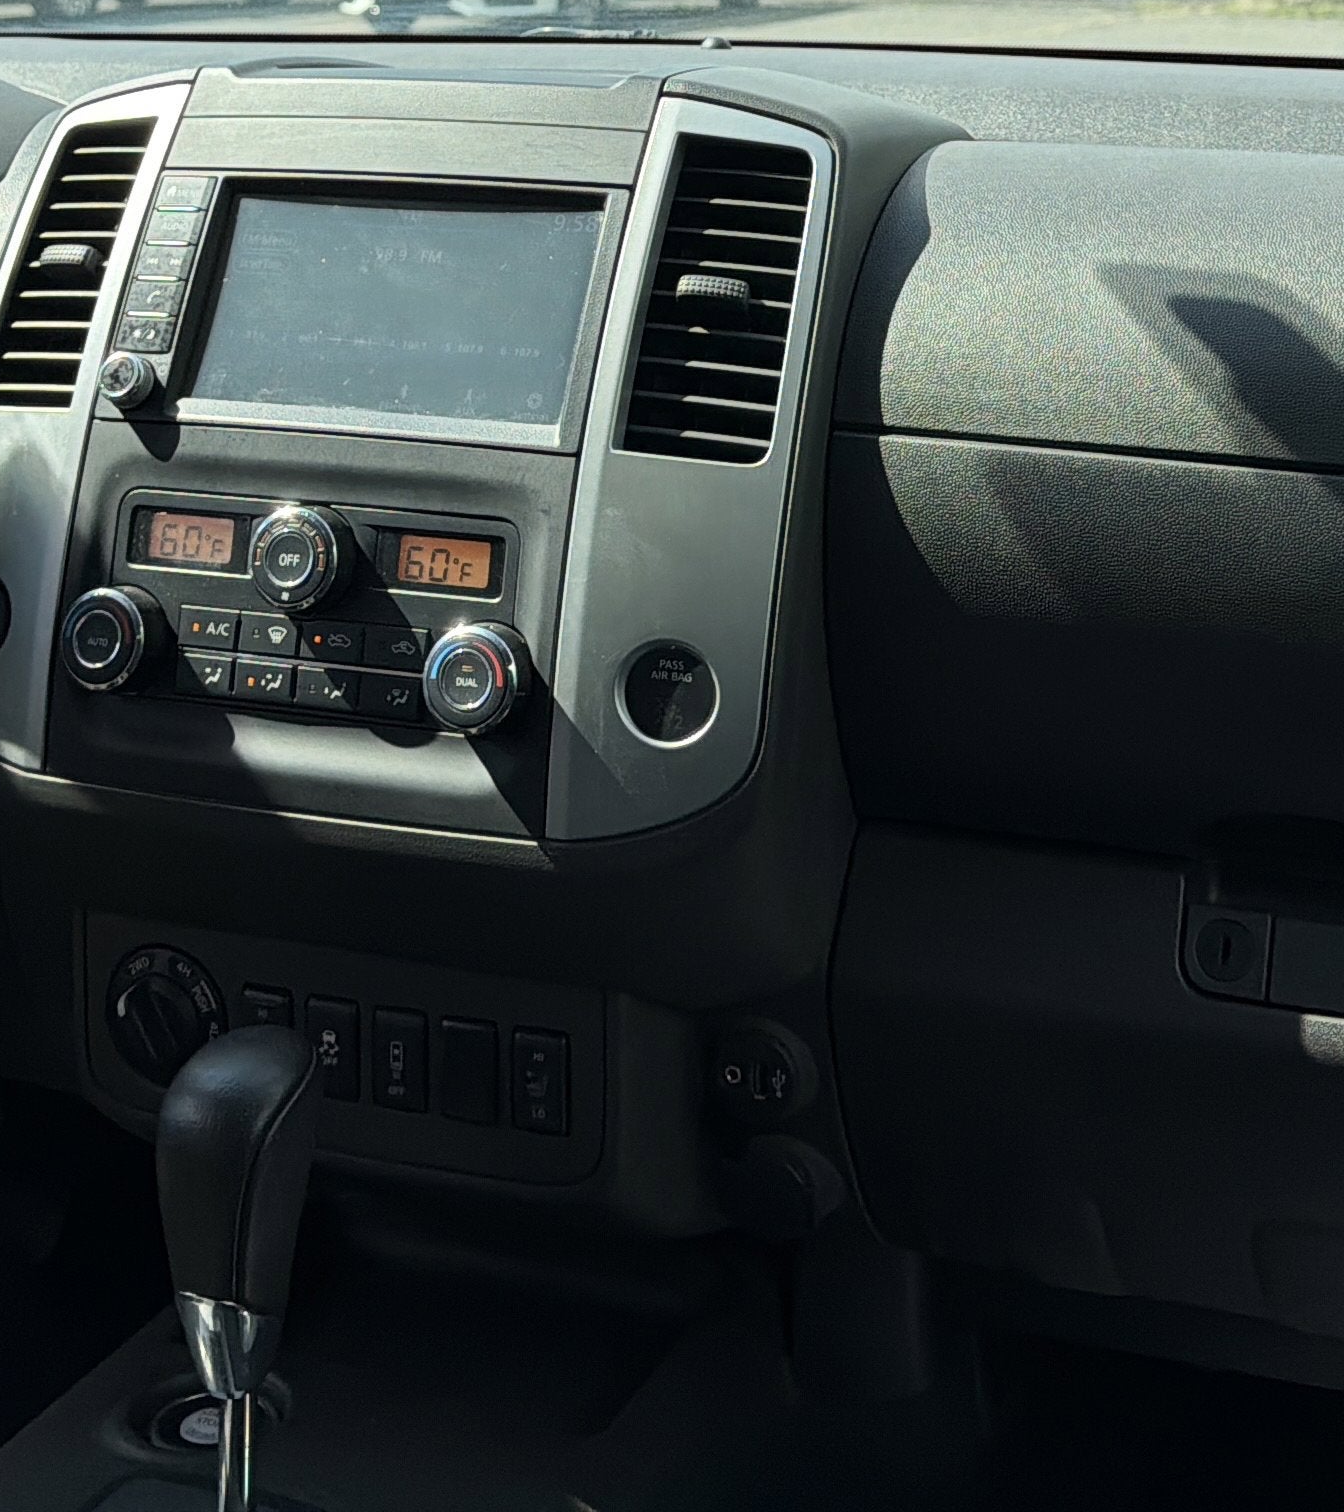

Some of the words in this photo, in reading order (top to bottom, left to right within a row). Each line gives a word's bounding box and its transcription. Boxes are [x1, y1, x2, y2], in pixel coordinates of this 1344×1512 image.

[420, 249, 444, 264] FM
[278, 552, 301, 569] OFF
[404, 545, 475, 583] 60°F
[206, 620, 231, 638] A/C
[87, 636, 109, 648] AUTO
[659, 659, 685, 671] PASS
[455, 675, 478, 689] DUAL
[651, 670, 669, 680] AIR
[671, 671, 693, 683] BAG
[128, 956, 150, 976] 2WD
[387, 1084, 405, 1096] OFF
[532, 1106, 546, 1119] LO
